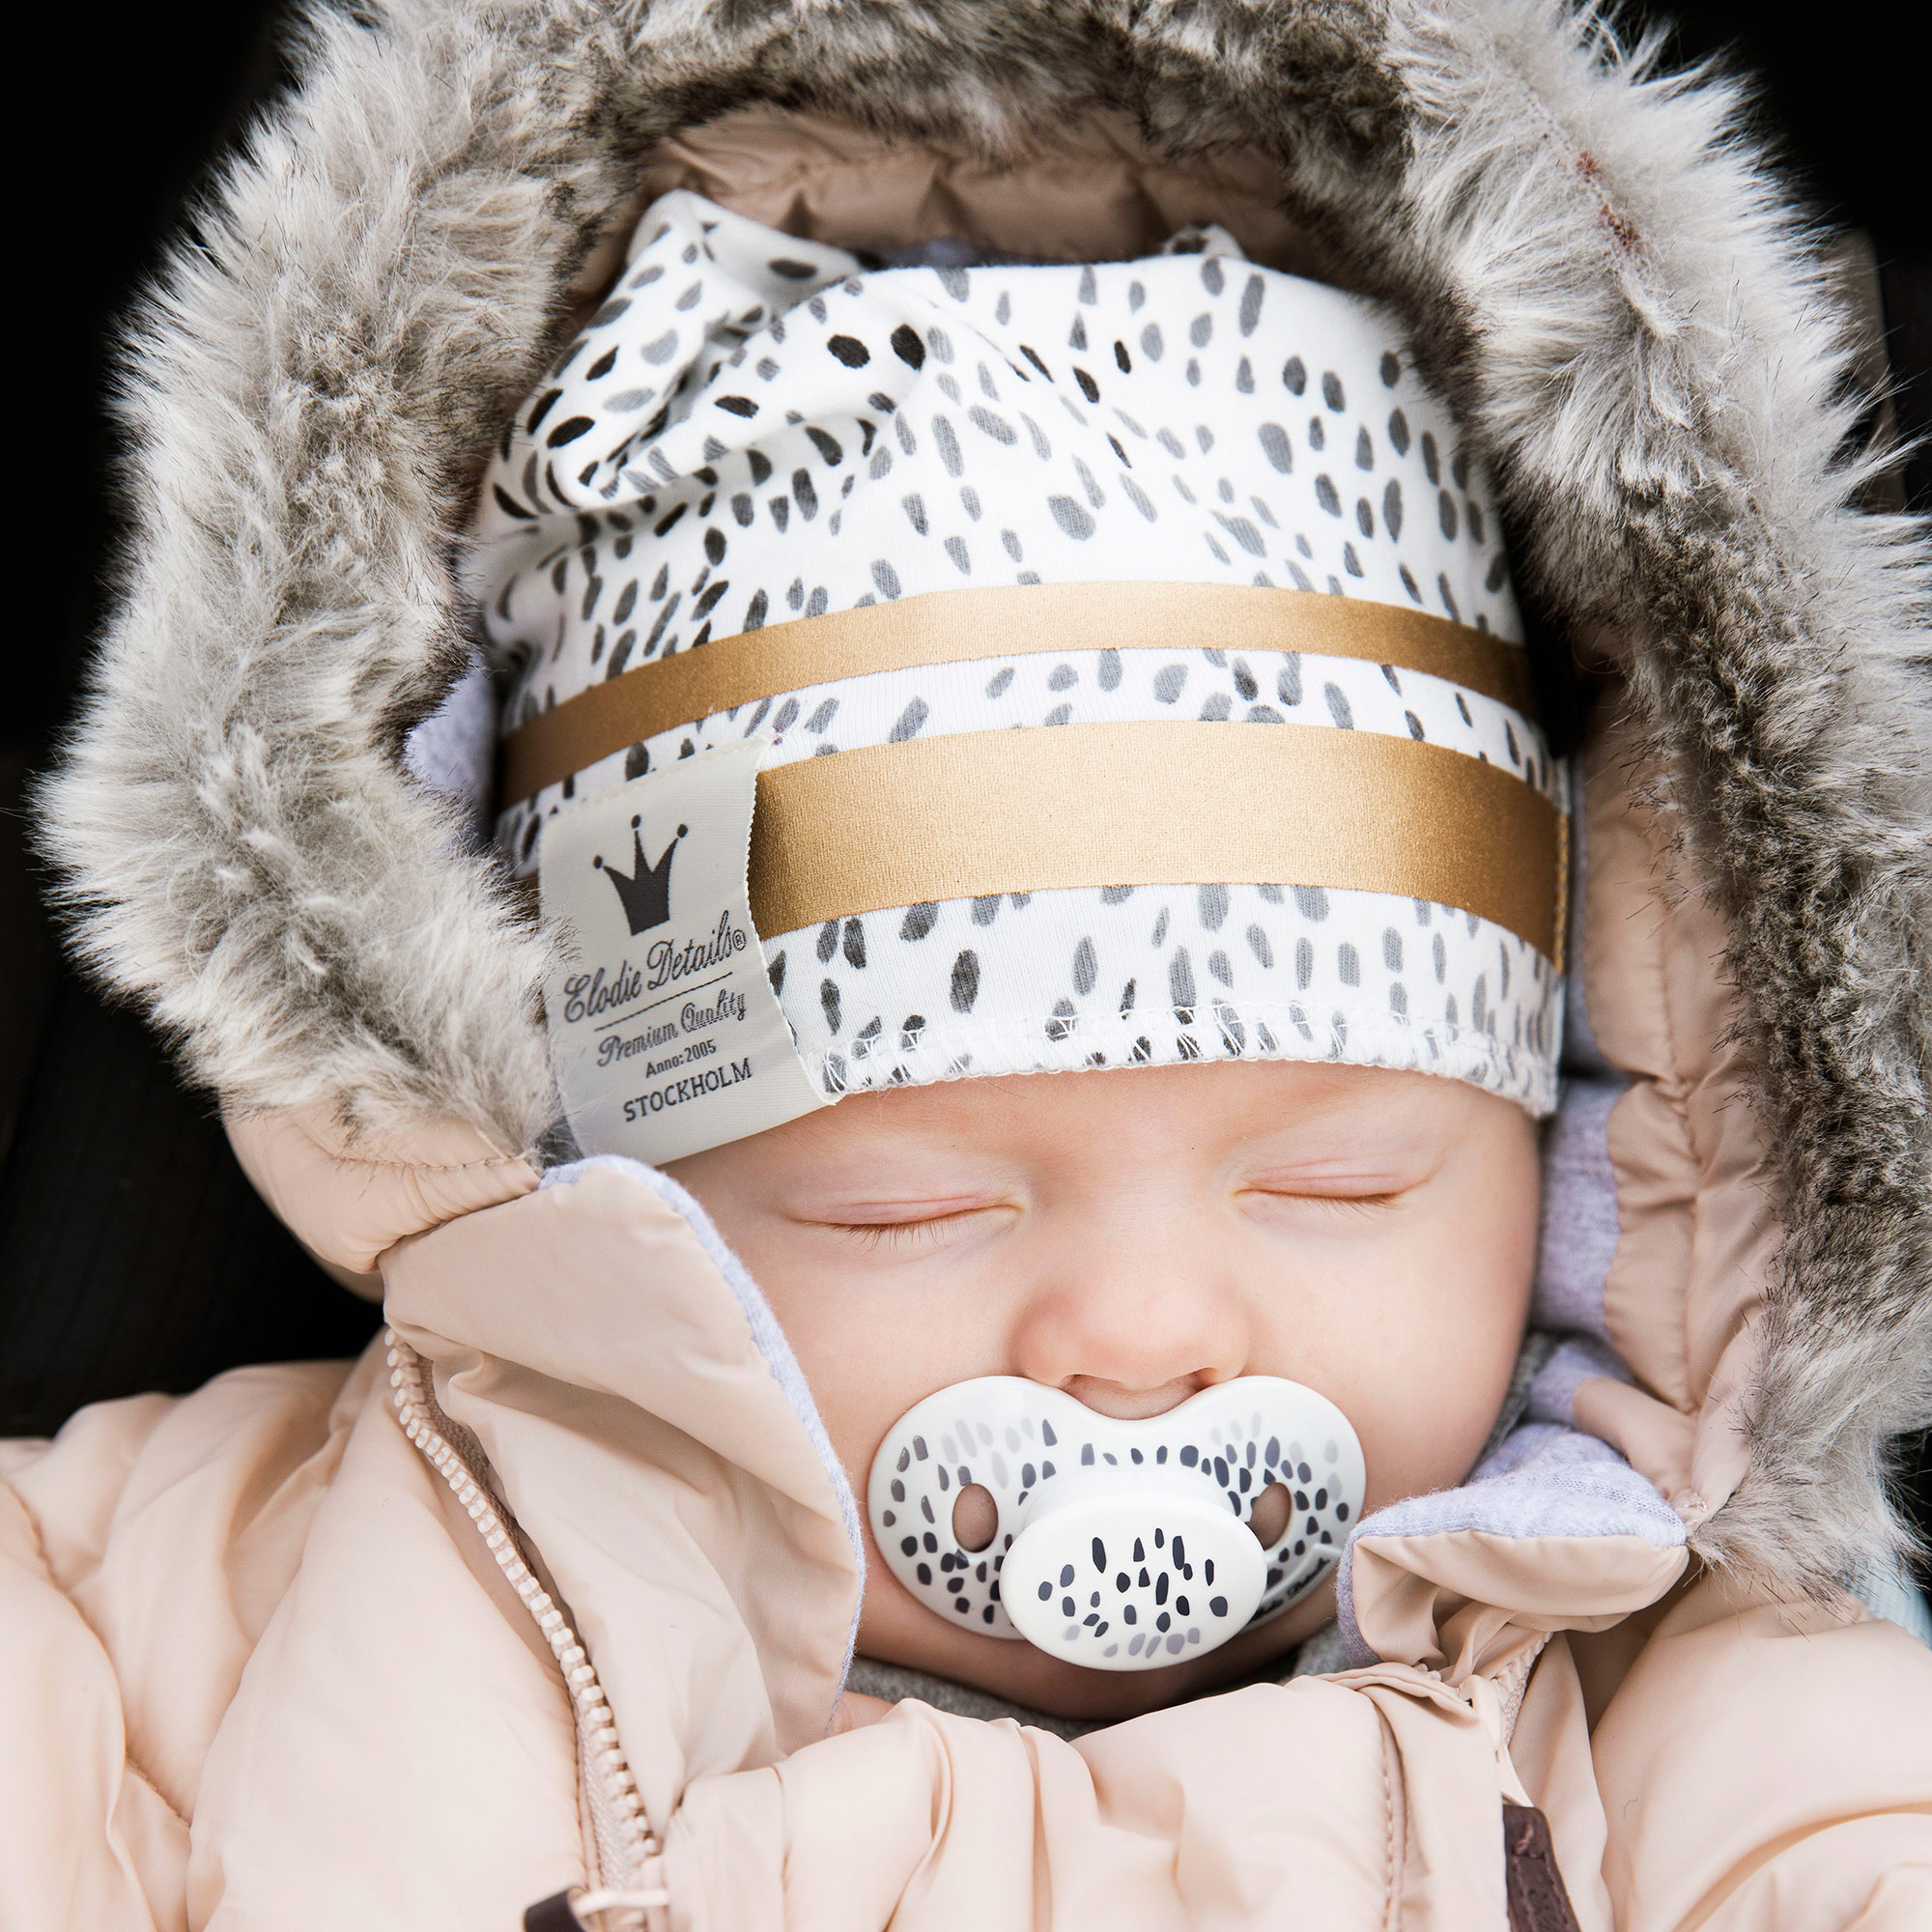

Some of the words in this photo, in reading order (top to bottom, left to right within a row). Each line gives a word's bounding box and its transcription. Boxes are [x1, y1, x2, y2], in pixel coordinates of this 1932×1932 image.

[563, 959, 642, 1023] Elodie
[597, 1022, 679, 1066] Premium
[623, 1057, 753, 1122] STOCKHOLM
